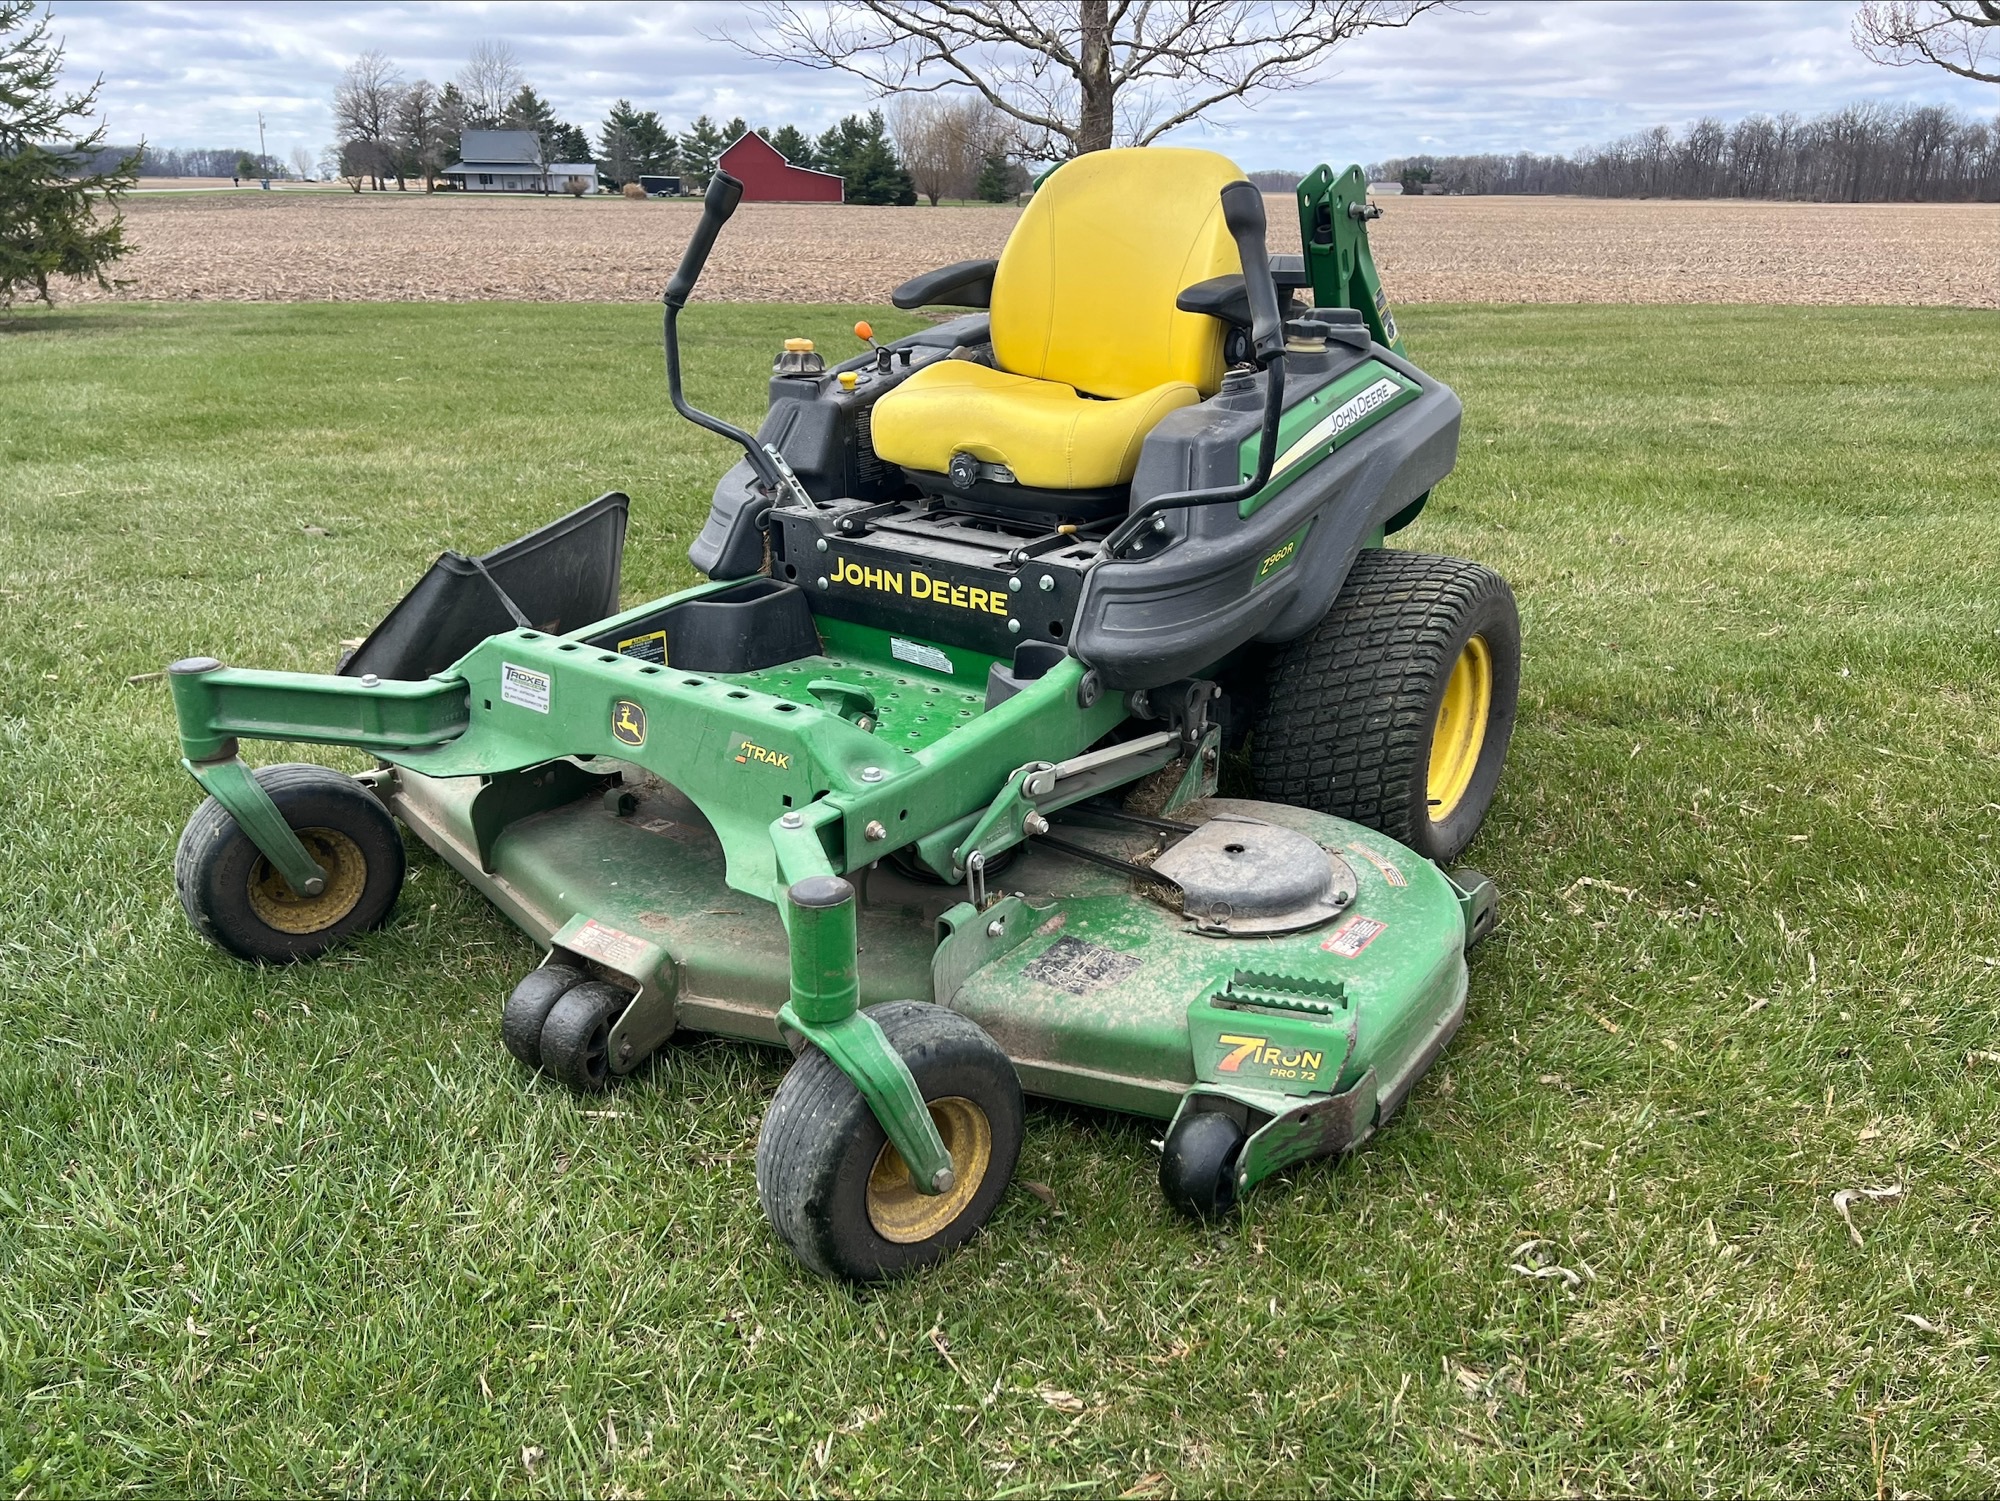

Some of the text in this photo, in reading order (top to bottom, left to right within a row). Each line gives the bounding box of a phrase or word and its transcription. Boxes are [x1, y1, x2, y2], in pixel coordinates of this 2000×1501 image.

[1331, 384, 1389, 434] JOHN DEERE
[1261, 541, 1294, 575] Z960R
[830, 556, 1008, 616] JOHN DEERE
[505, 665, 547, 688] TROXEL
[1269, 1067, 1317, 1081] PRO 72
